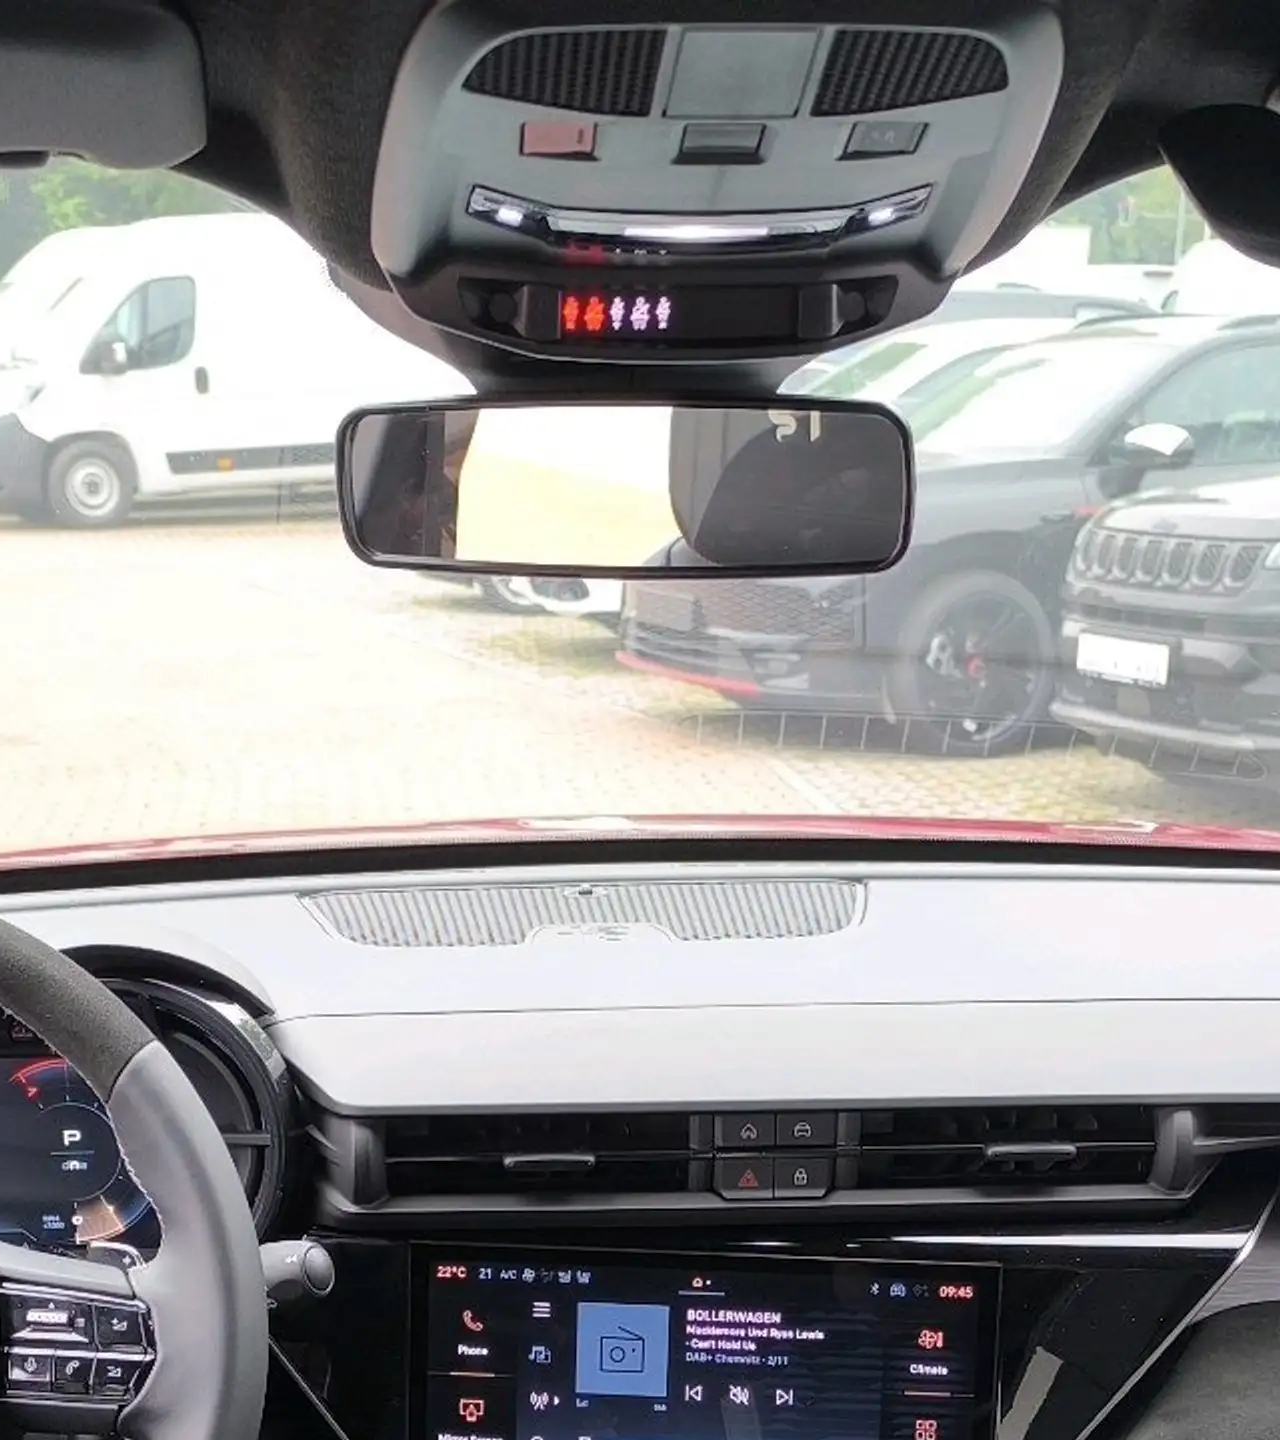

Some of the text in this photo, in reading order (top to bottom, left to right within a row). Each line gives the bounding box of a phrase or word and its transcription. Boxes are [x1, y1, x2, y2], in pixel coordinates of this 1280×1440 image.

[62, 1130, 81, 1146] P
[479, 1268, 492, 1279] 21
[938, 1286, 973, 1298] 09:45
[686, 1308, 782, 1323] BOLLERWAGEN
[748, 1327, 767, 1338] Und
[770, 1328, 794, 1339] Ryan
[796, 1329, 825, 1340] Lewis
[457, 1344, 489, 1356] Phone
[718, 1340, 740, 1350] Hold
[742, 1341, 756, 1351] Us
[686, 1352, 789, 1367] DAB+ Chemnitz 2/11
[909, 1364, 949, 1376] Climate
